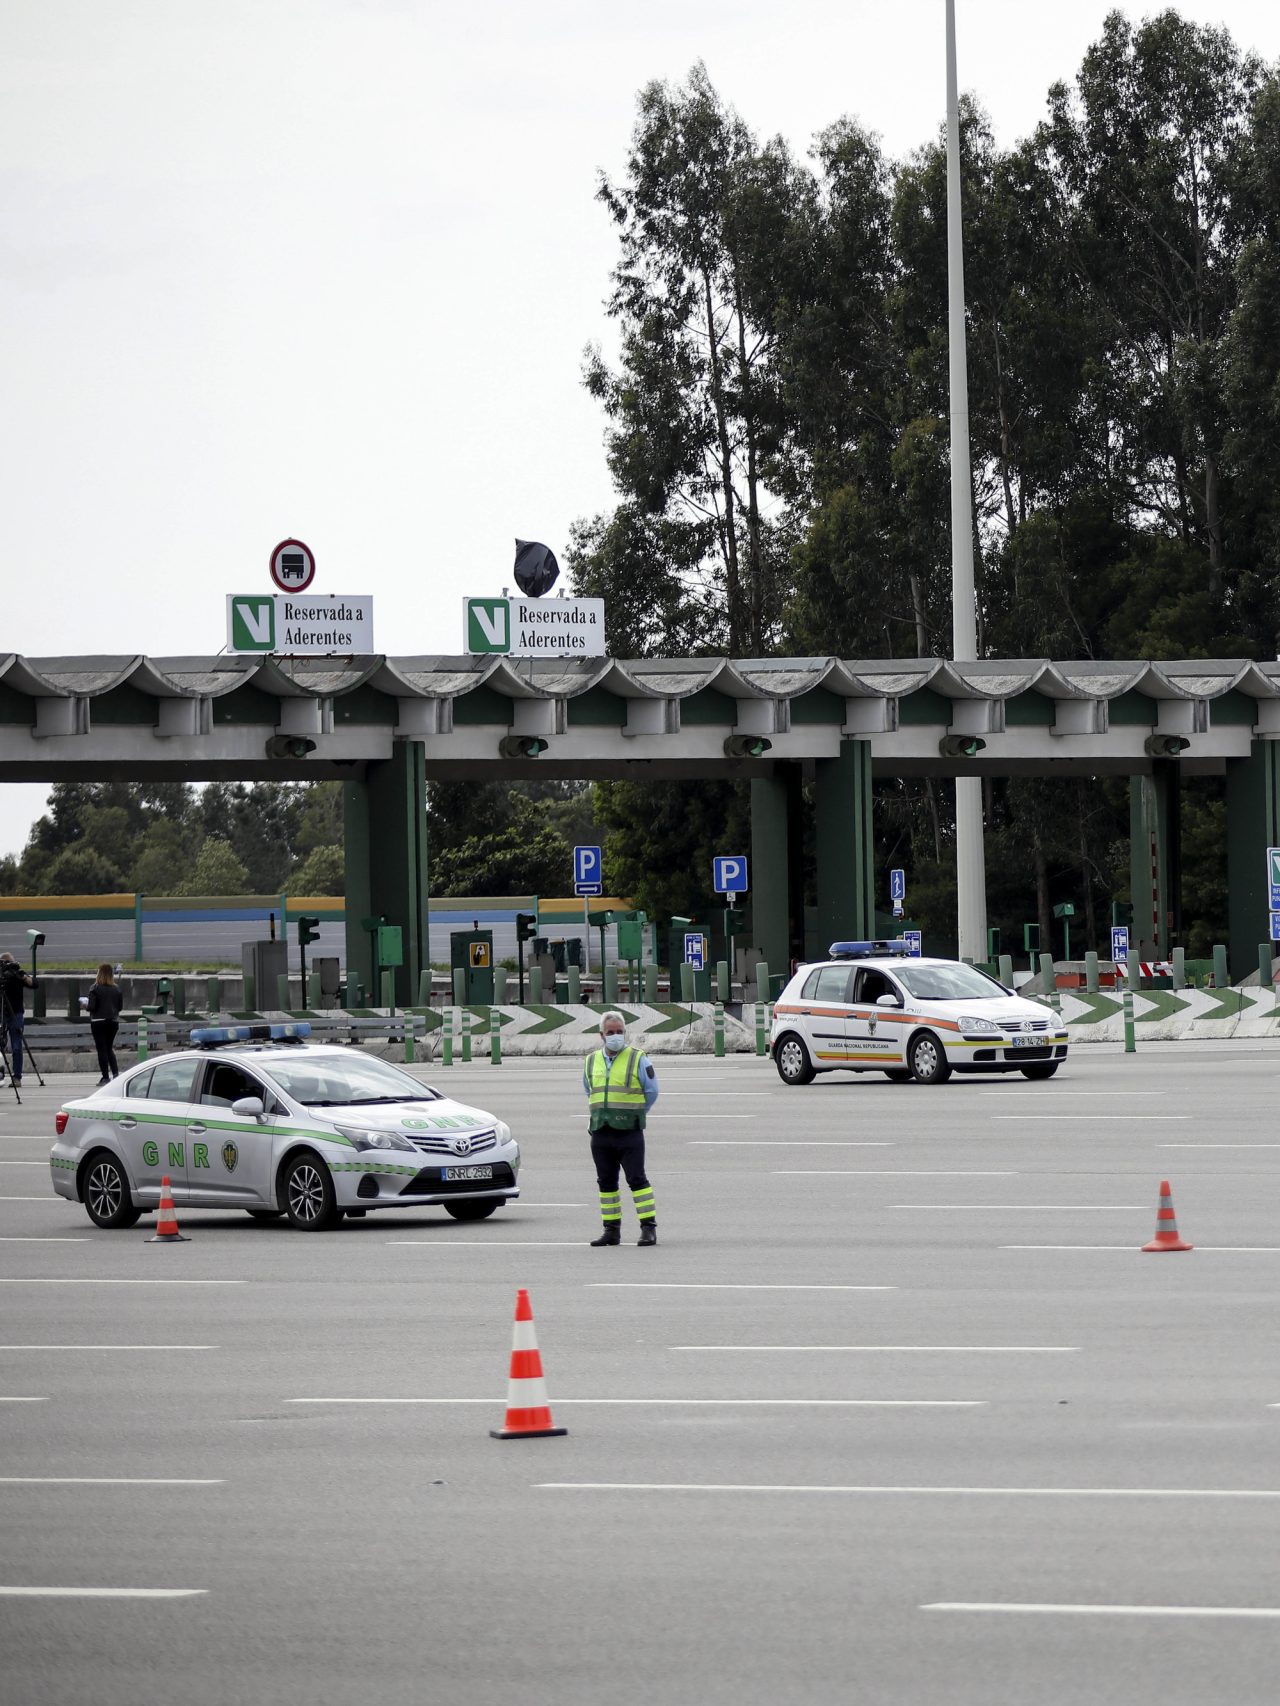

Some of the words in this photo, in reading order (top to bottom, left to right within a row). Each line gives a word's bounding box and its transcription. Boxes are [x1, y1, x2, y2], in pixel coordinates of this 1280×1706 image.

[285, 603, 353, 620] Reservada
[356, 608, 363, 621] a
[520, 606, 586, 624] Reservada
[589, 611, 597, 624] a
[285, 627, 352, 645] Aderentes
[519, 630, 585, 648] Aderentes
[580, 850, 595, 880] P
[720, 860, 740, 889] P
[400, 1115, 484, 1129] GNR
[143, 1140, 210, 1168] GNR
